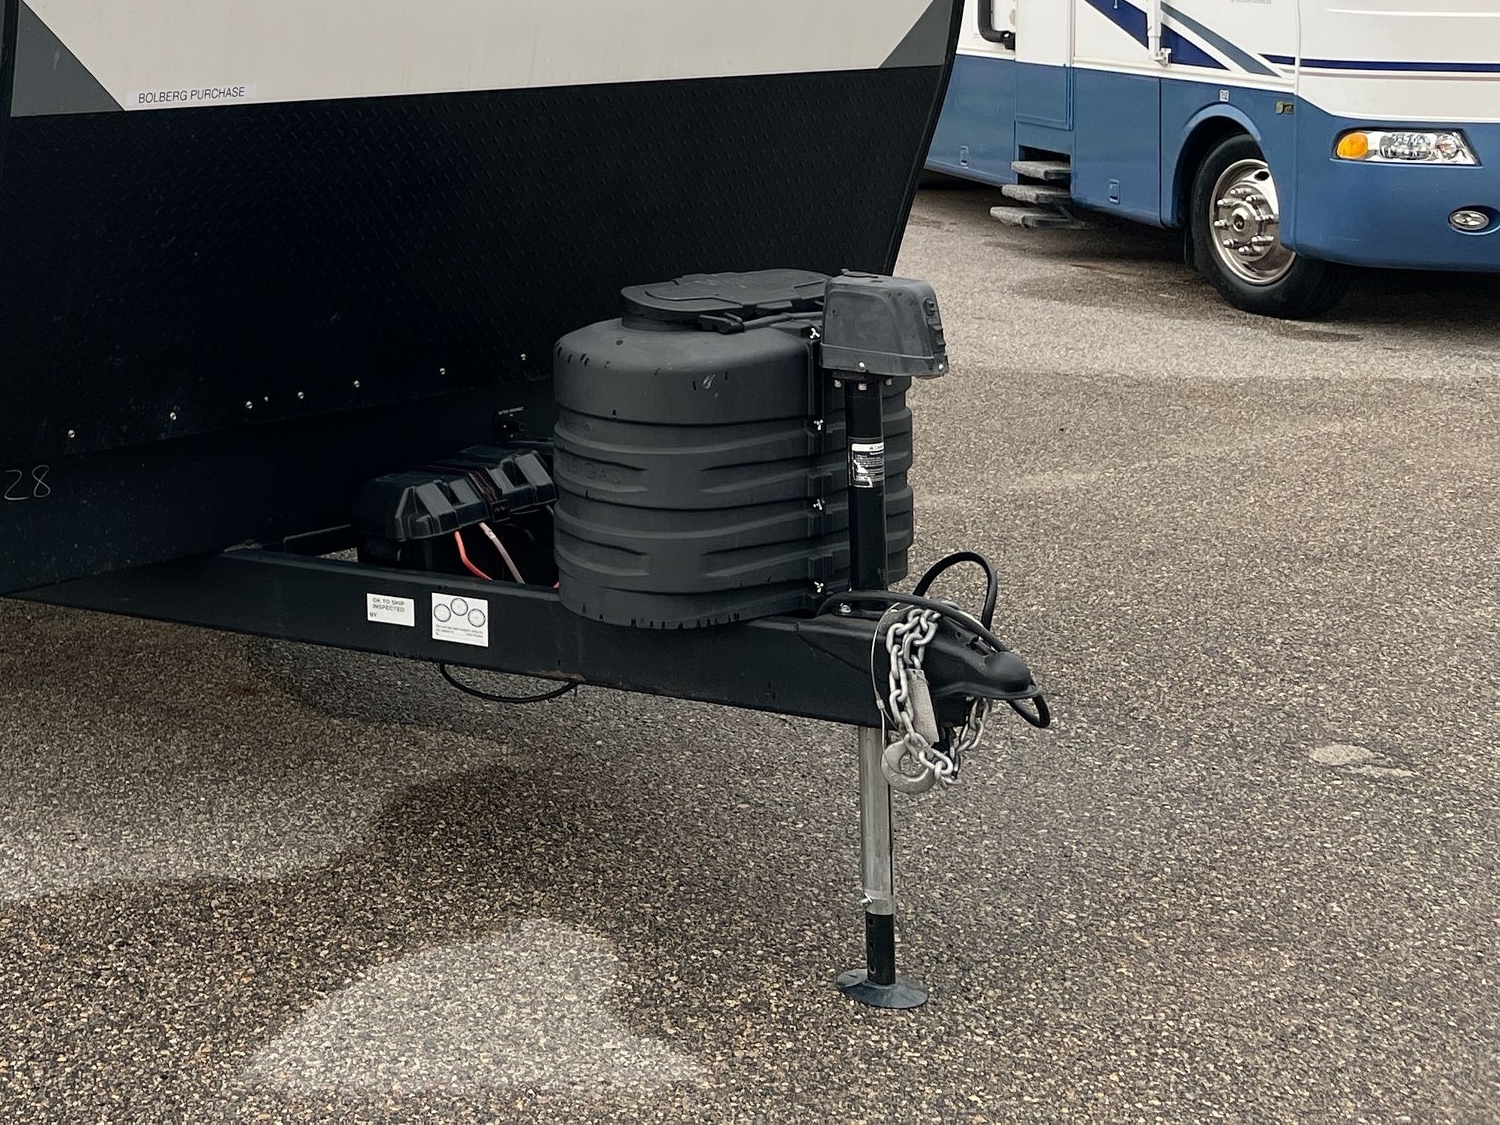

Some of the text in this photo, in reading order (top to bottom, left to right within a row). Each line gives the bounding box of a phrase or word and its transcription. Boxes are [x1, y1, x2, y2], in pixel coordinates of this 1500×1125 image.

[138, 86, 246, 104] BOLBERG PURCHASE
[3, 464, 51, 501] 28
